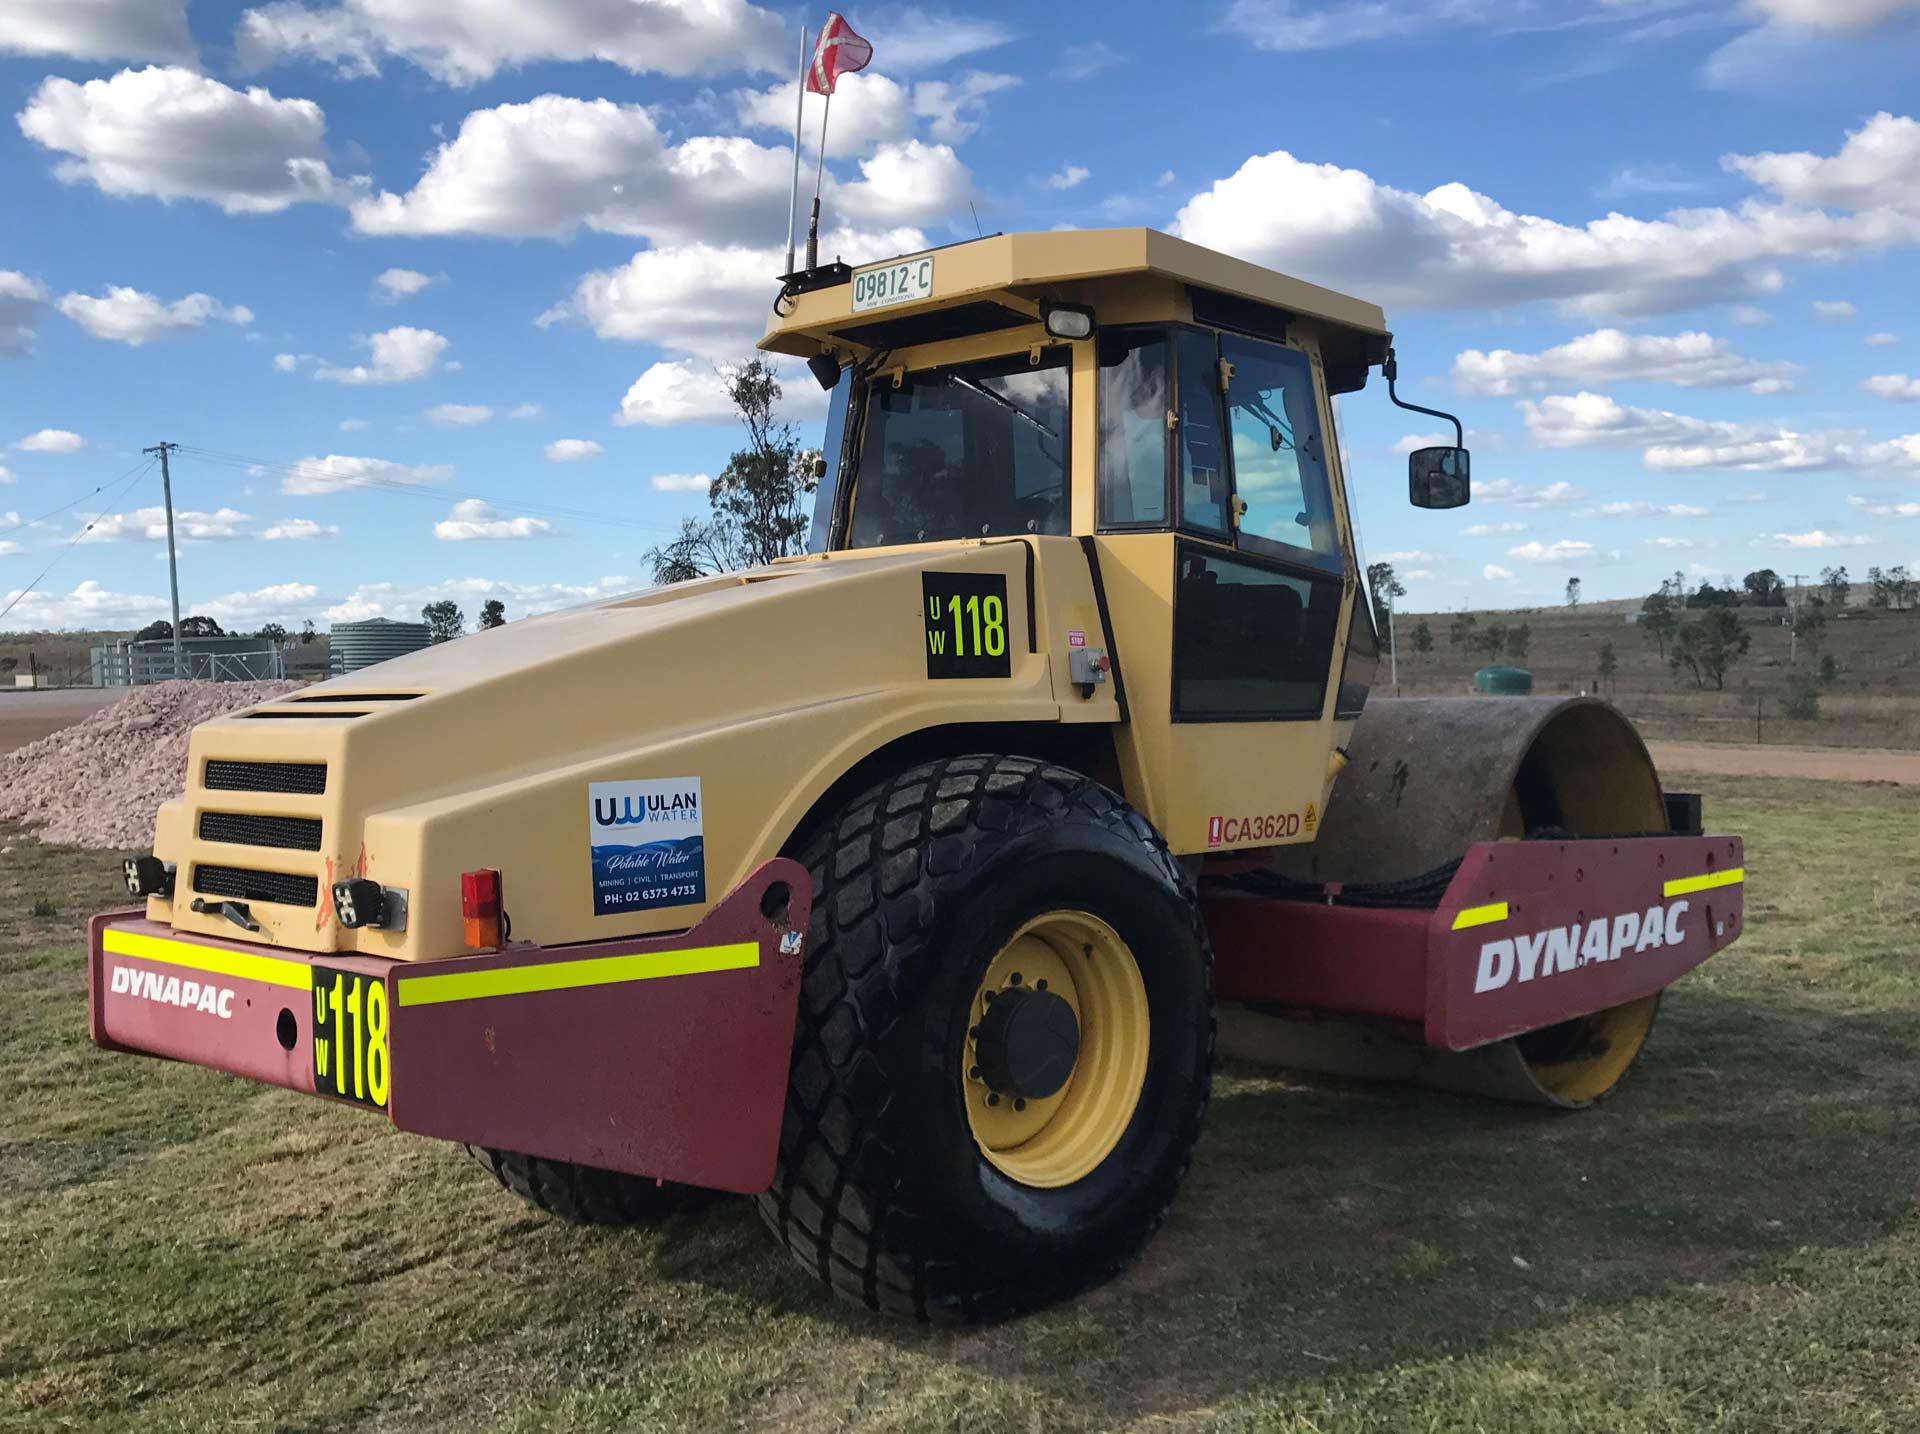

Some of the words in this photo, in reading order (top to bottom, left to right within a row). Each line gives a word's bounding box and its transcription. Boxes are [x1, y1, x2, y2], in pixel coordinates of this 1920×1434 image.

[929, 596, 941, 620] U
[948, 594, 1005, 657] 118
[928, 630, 946, 655] W
[1071, 637, 1084, 645] STOP
[647, 792, 697, 811] ULAN
[648, 810, 698, 822] WATER
[1223, 814, 1300, 843] CA362D
[606, 854, 650, 873] Potable
[651, 850, 690, 868] Water
[599, 878, 625, 888] MINING
[633, 875, 652, 884] CIVIL
[660, 870, 699, 881] TRANSPORT
[604, 893, 623, 905] PH:
[625, 891, 640, 902] 02
[642, 887, 668, 900] 6373
[670, 884, 696, 897] 4733
[1474, 900, 1690, 994] DYNAPAC
[111, 966, 235, 1019] DYNAPAC
[316, 986, 327, 1025] U
[329, 973, 389, 1107] 118
[315, 1037, 329, 1077] W
